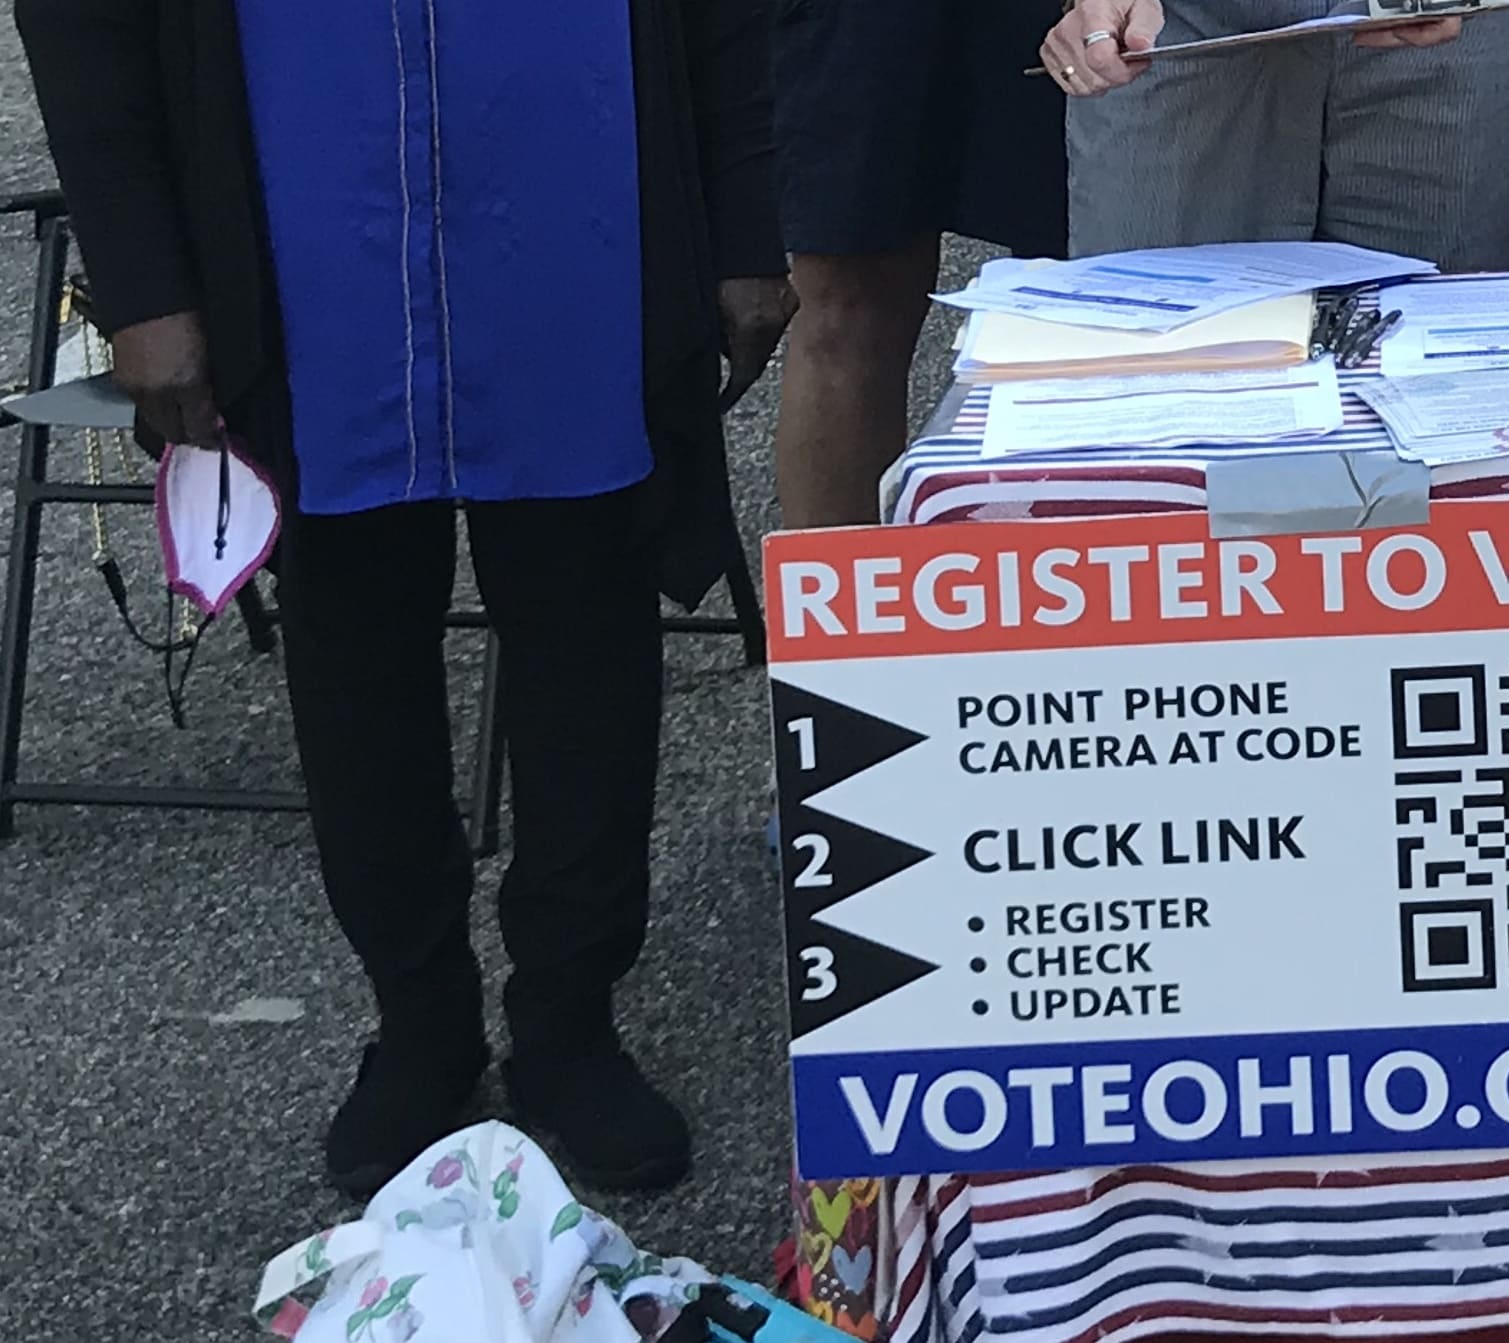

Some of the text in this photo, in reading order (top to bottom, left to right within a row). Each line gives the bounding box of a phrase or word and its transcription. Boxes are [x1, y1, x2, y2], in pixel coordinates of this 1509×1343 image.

[779, 540, 1285, 638] REGISTER
[1300, 533, 1447, 612] TO
[957, 681, 1289, 729] POINT PHONE
[787, 717, 816, 770] 1
[959, 724, 1362, 775] CAMERA AT CODE
[792, 834, 833, 887] 2
[963, 815, 1306, 874] CLICK LINK
[1006, 897, 1210, 936] REGISTER
[800, 946, 837, 1000] 3
[1007, 942, 1152, 979] CHECK
[1010, 983, 1181, 1021] UPDATE
